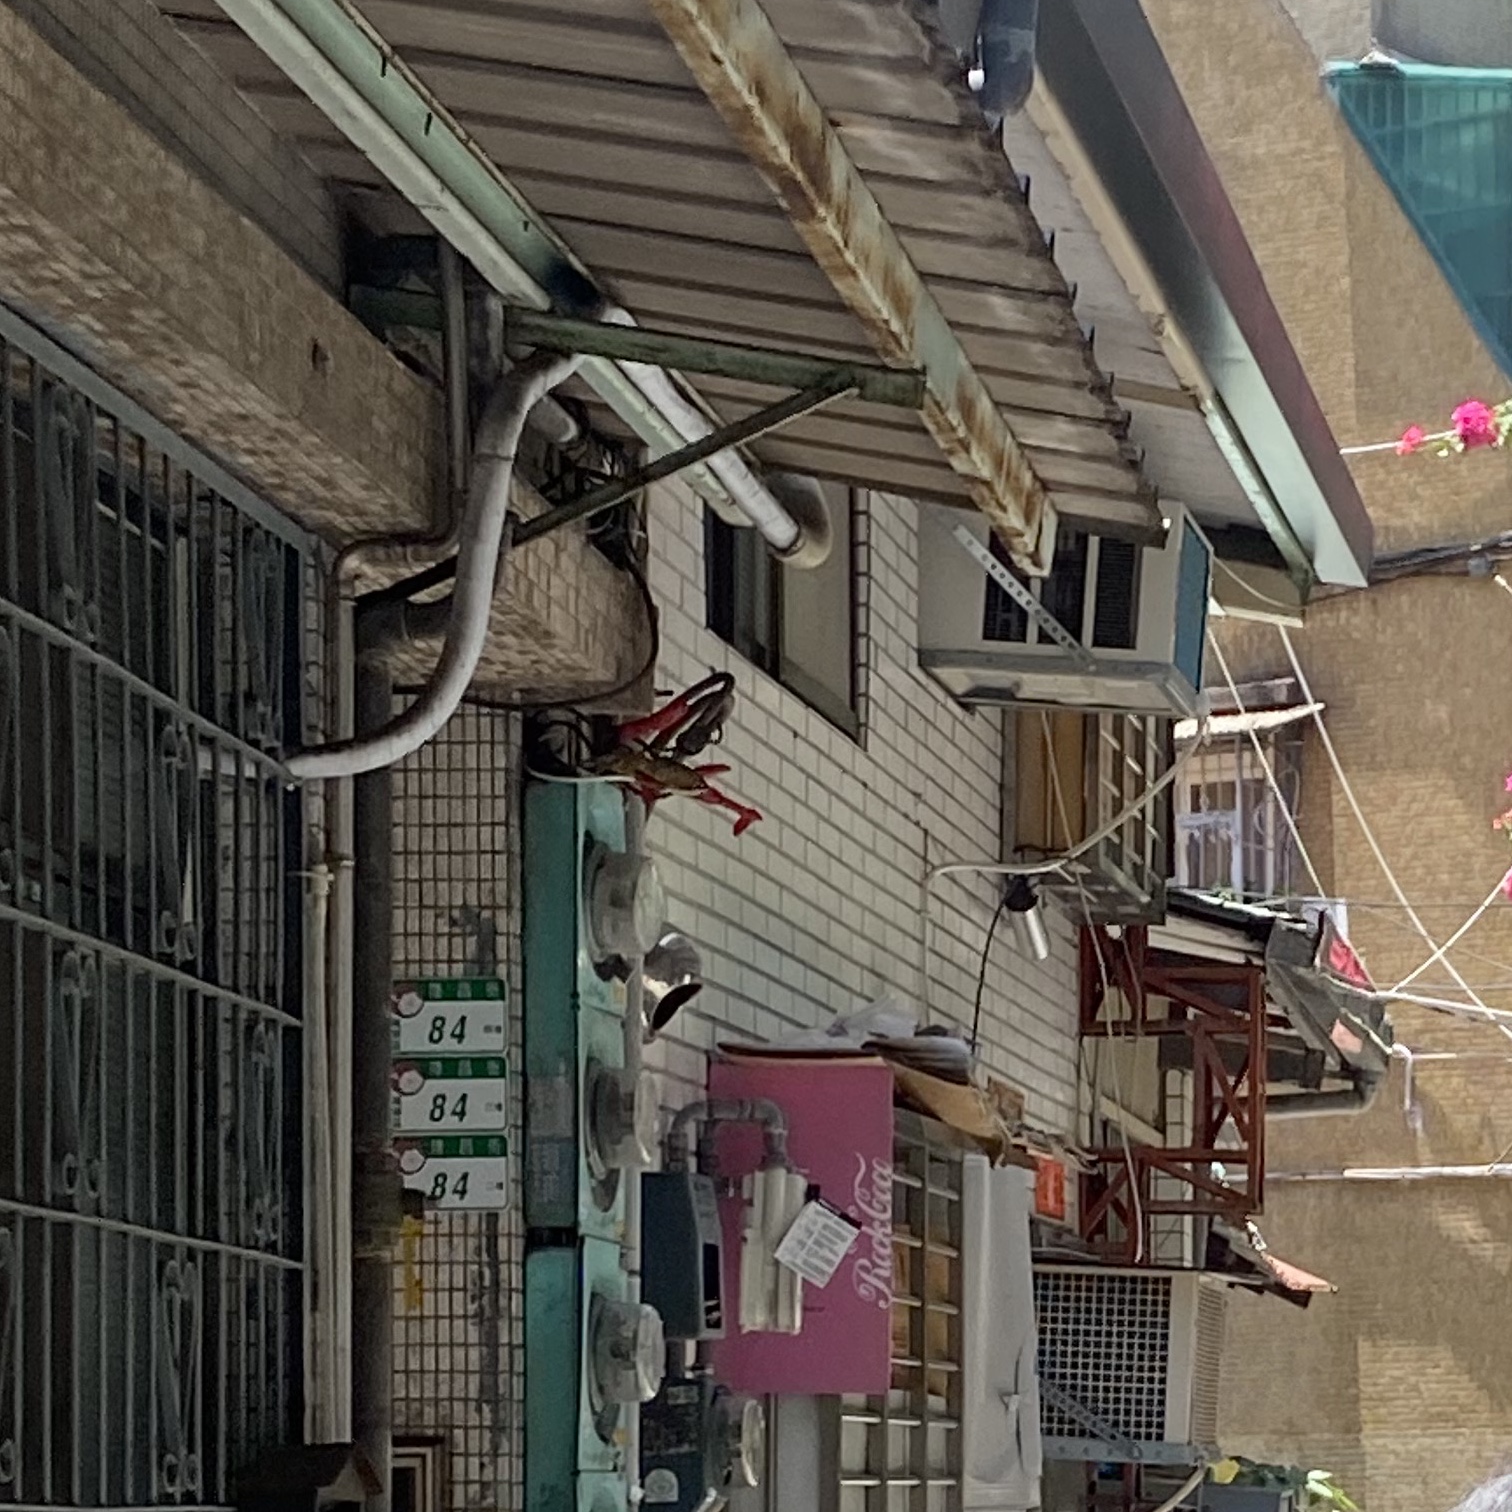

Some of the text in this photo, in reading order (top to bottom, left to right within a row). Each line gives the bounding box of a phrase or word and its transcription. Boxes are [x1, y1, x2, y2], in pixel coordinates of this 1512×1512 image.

[428, 1015, 467, 1044] 84
[429, 1093, 468, 1122] 84
[431, 1172, 470, 1201] 84
